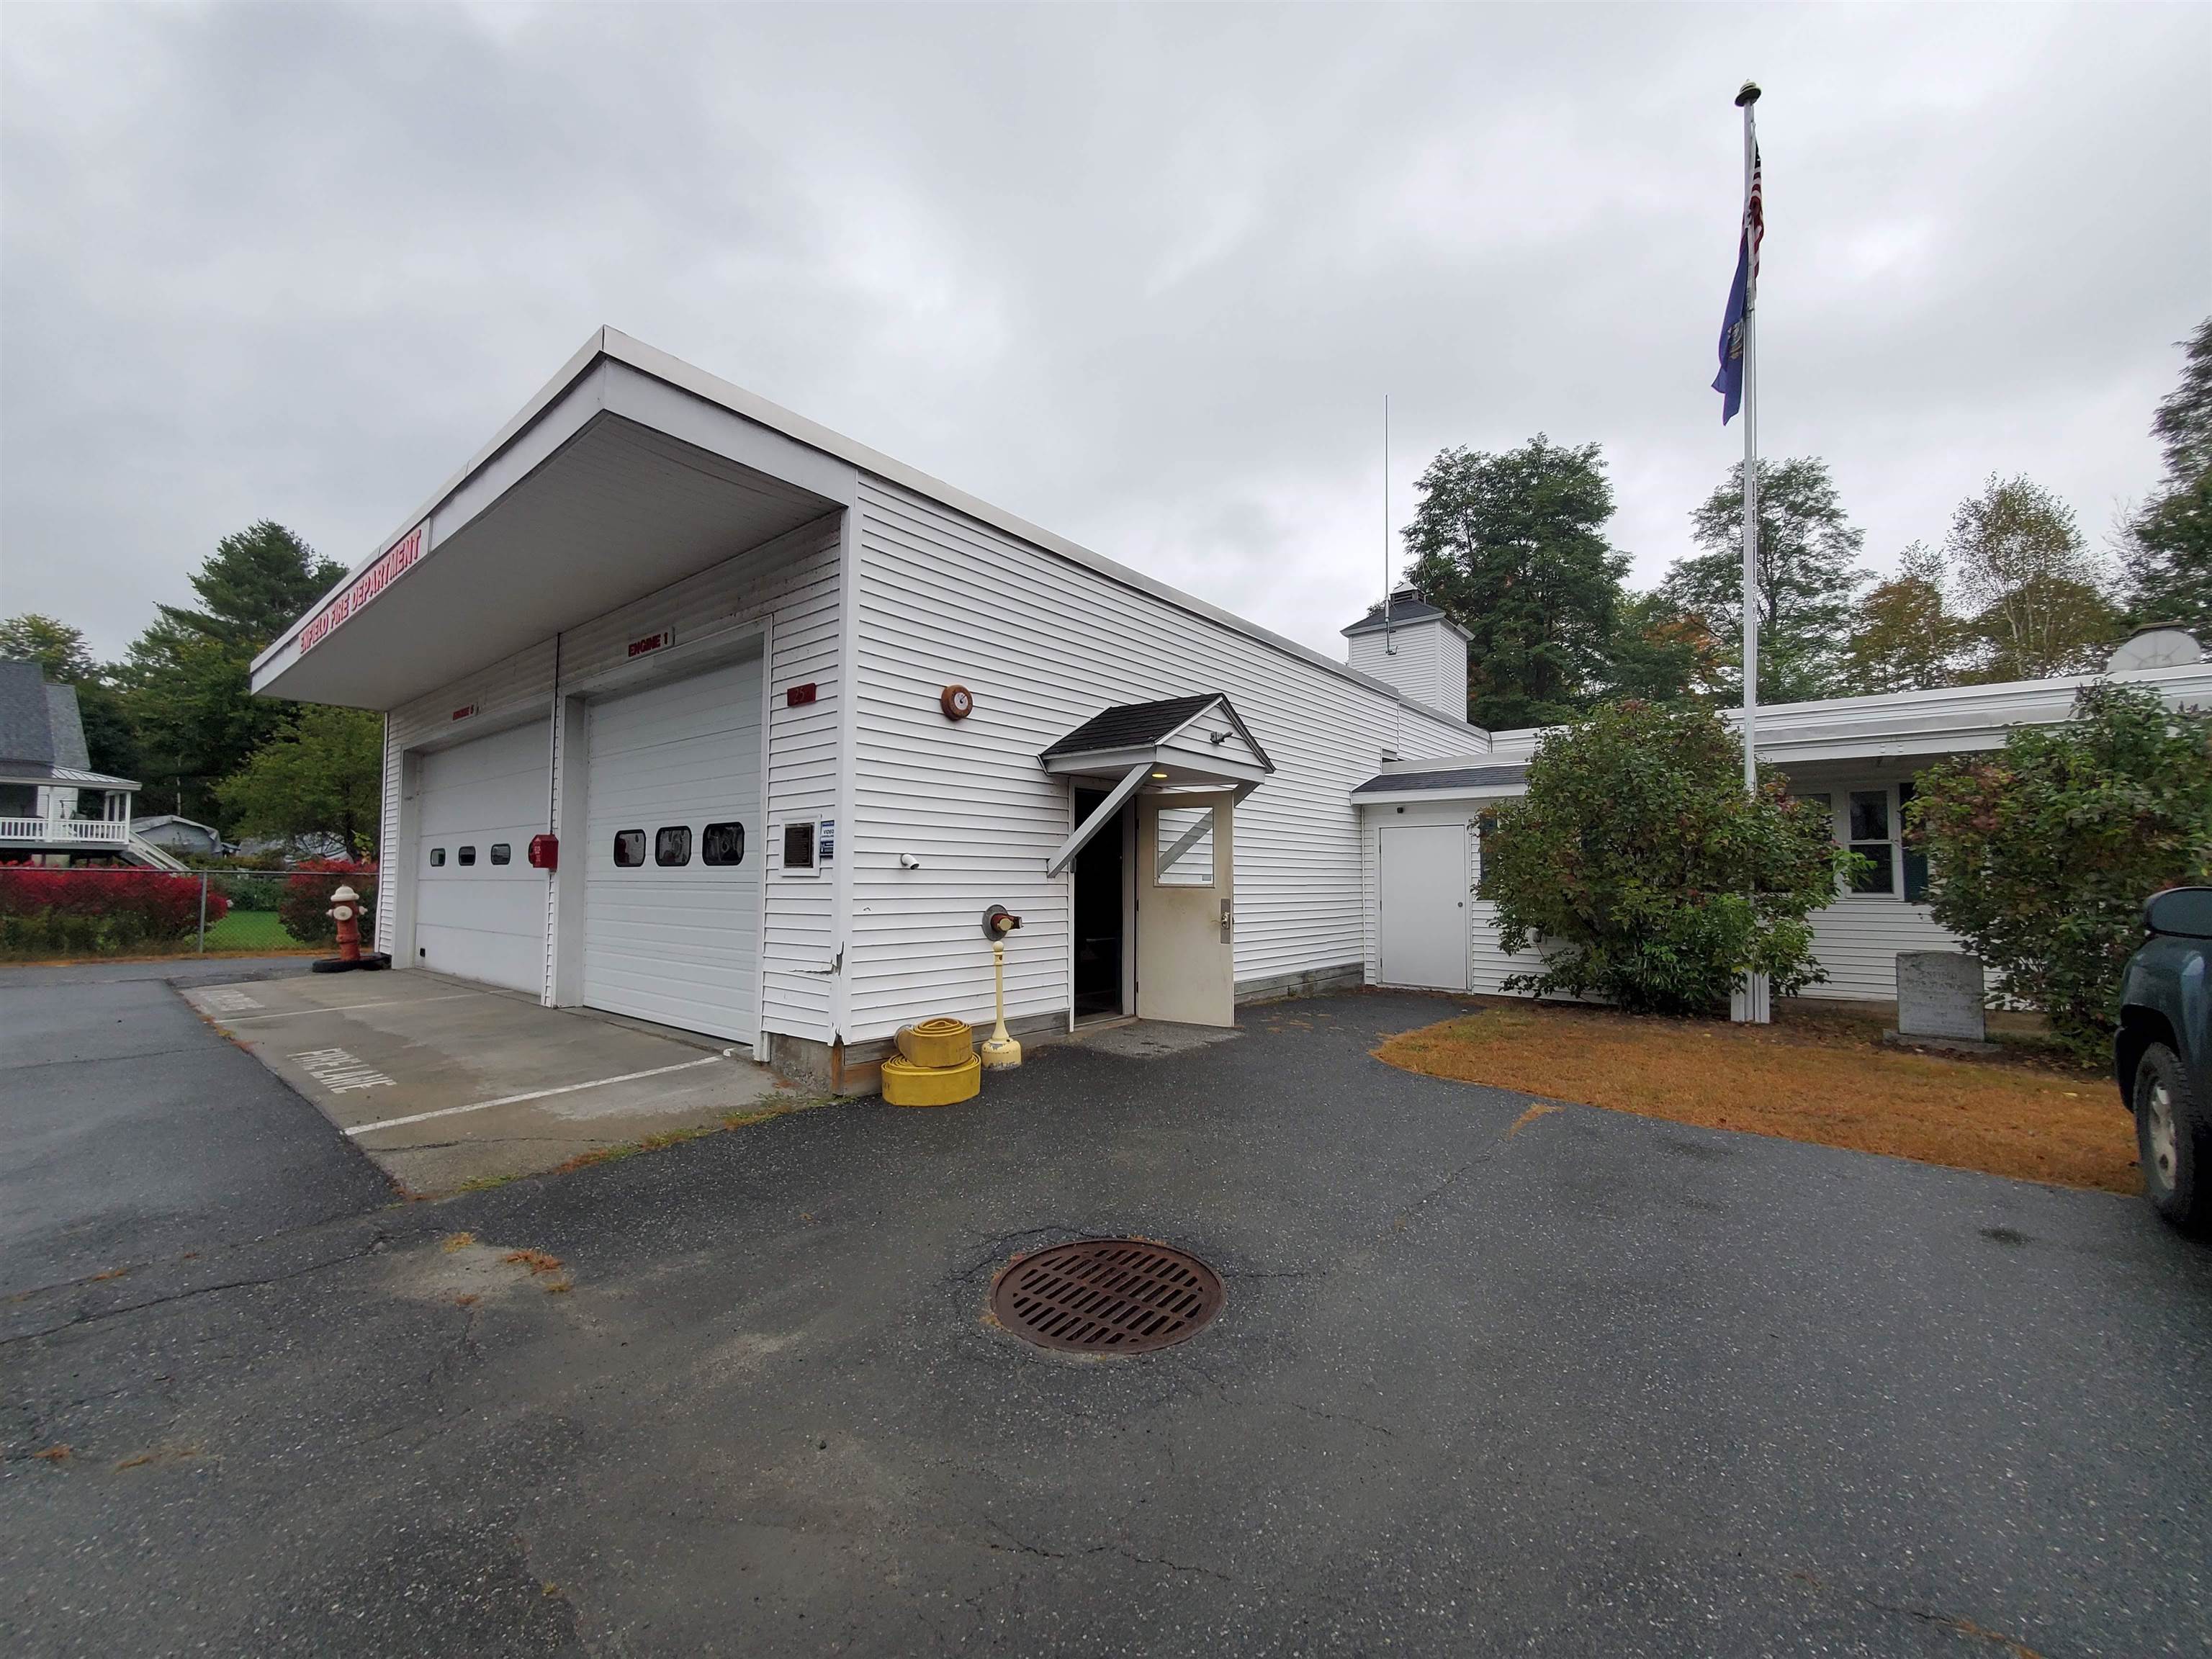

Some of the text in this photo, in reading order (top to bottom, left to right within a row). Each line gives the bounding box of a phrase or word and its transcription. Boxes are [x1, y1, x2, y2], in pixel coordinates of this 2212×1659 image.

[300, 529, 421, 654] ENFIELD FIRE DEPARTMENT
[629, 634, 661, 657] ENGINE
[286, 1047, 397, 1094] FIRE LANE
